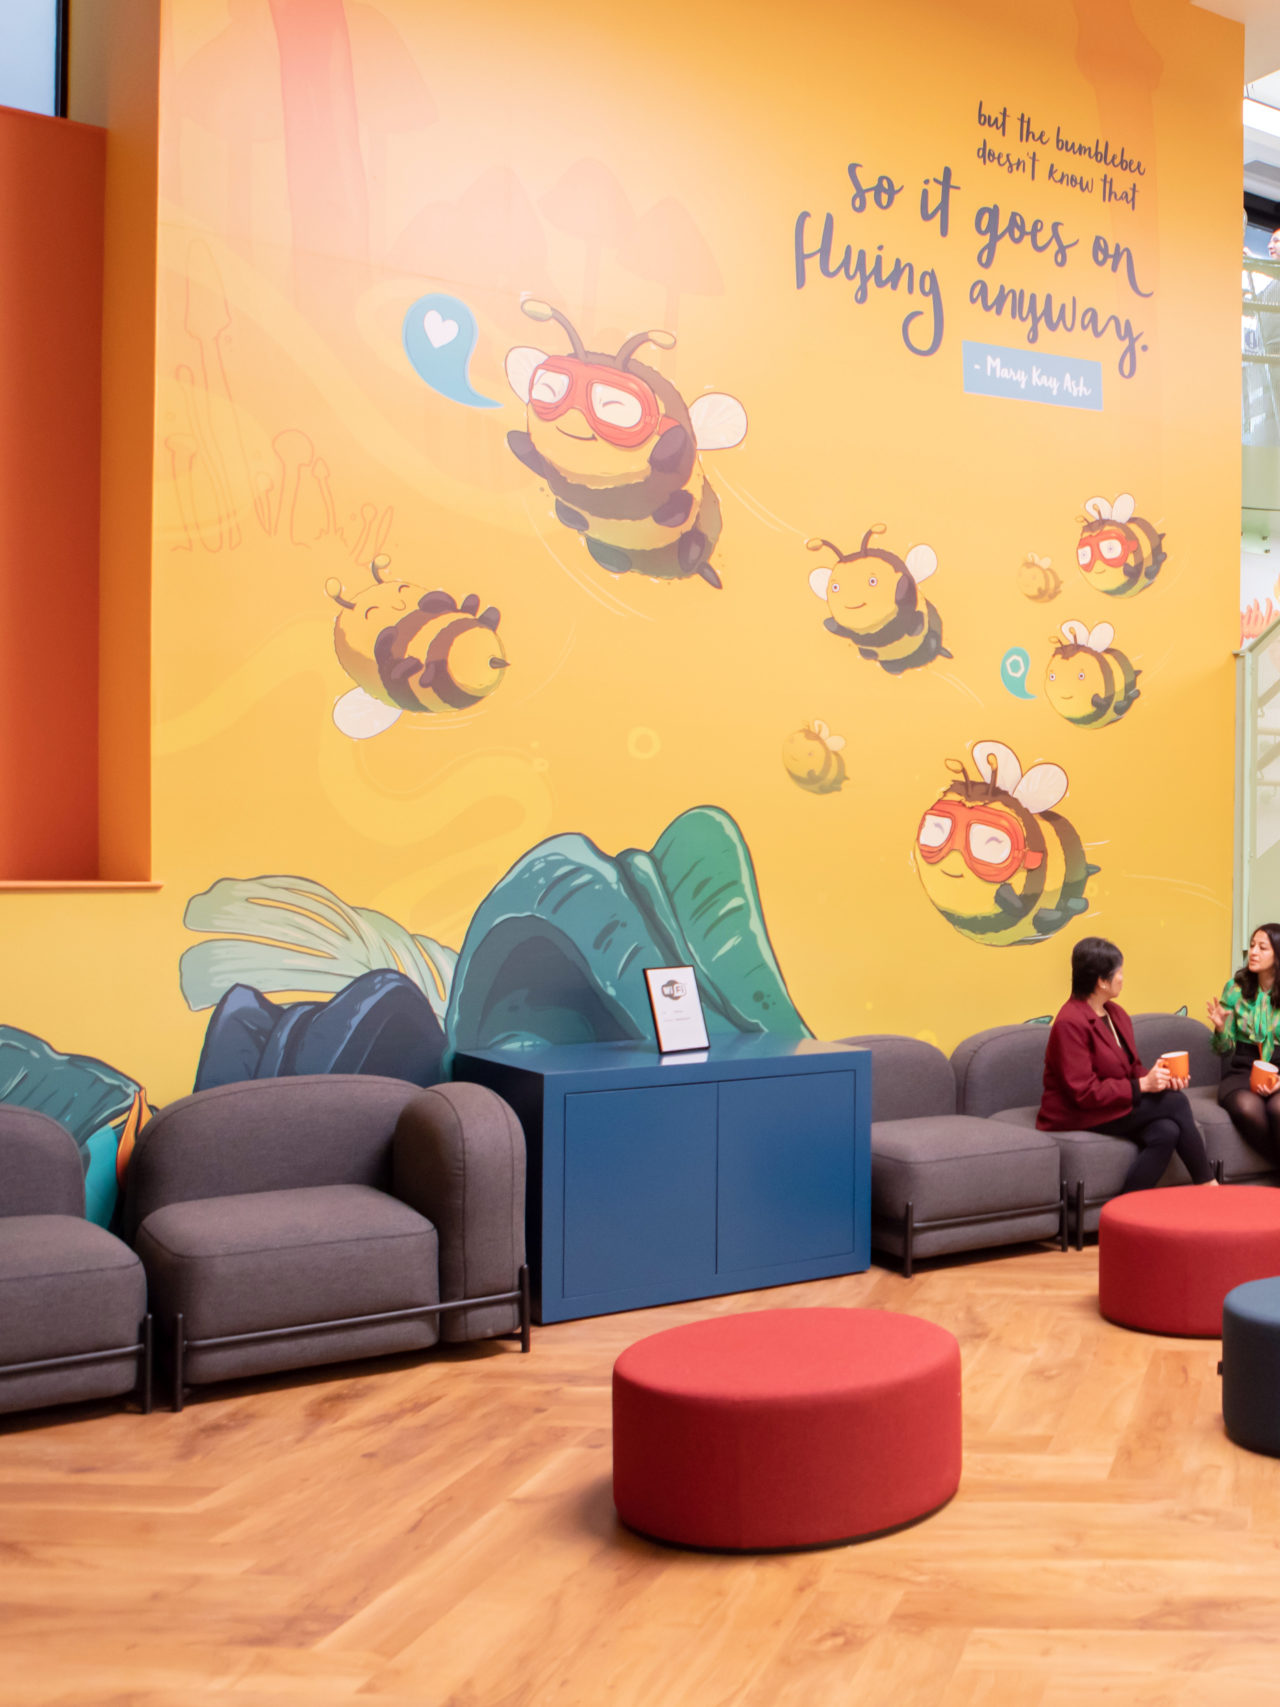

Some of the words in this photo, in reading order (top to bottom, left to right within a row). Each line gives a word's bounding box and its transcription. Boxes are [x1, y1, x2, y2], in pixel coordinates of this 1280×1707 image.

[977, 138, 1040, 181] doesn't
[1048, 163, 1094, 193] know
[1101, 173, 1139, 211] that
[978, 100, 1010, 137] but
[1017, 112, 1050, 145] the
[1056, 126, 1146, 176] bumblebee
[848, 162, 905, 213] so
[920, 166, 961, 237] it
[974, 204, 1080, 269] goes
[1092, 235, 1154, 298] on
[794, 210, 944, 357] flying
[968, 279, 1149, 379] anyway.
[986, 354, 1029, 389] Mary
[1031, 364, 1061, 396] Kay
[1063, 371, 1092, 397] Ash
